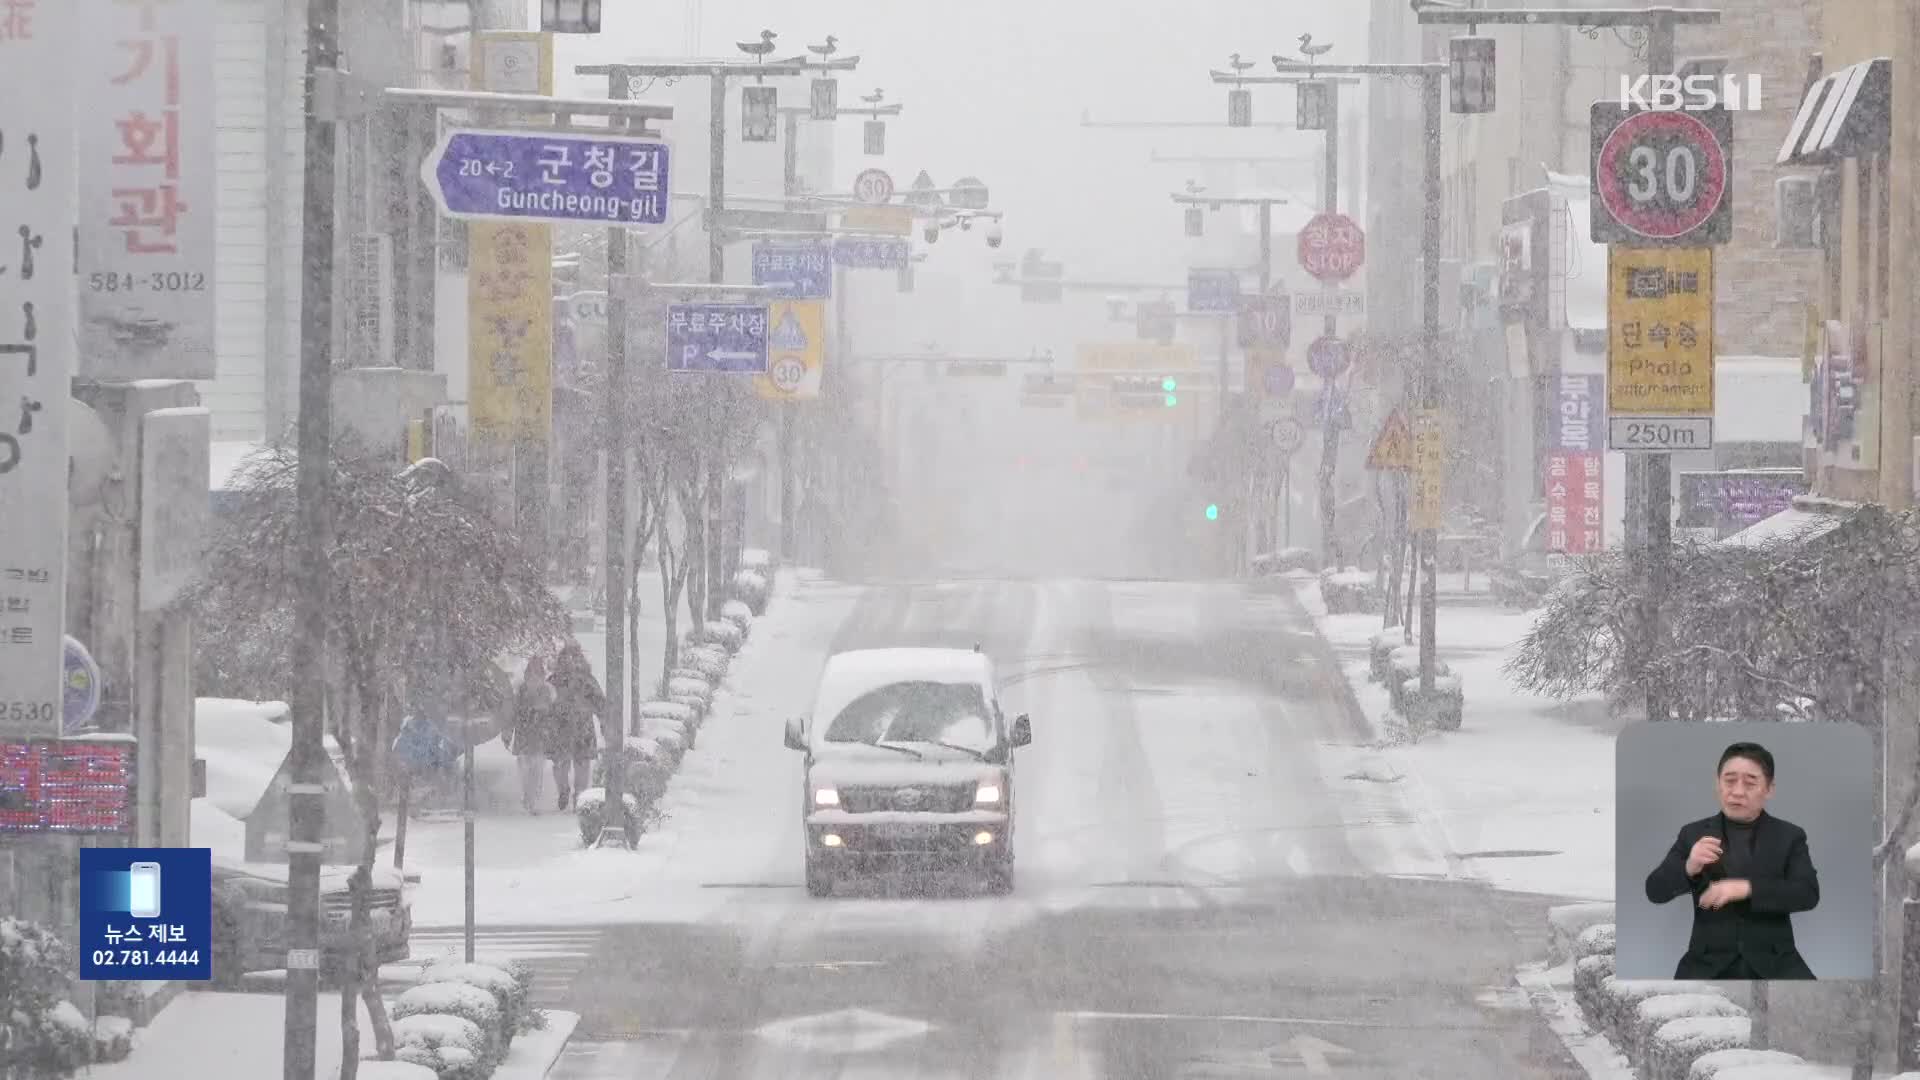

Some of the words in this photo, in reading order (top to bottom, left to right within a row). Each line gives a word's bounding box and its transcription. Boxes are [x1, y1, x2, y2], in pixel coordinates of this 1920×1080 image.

[535, 144, 660, 191] 군청길
[1628, 146, 1696, 201] 30
[498, 186, 658, 217] Guncheong-gil
[90, 272, 206, 292] 584-3012
[670, 310, 766, 335] 무료주차장
[682, 344, 698, 369] P
[776, 365, 801, 384] 30
[1626, 423, 1695, 445] 250m
